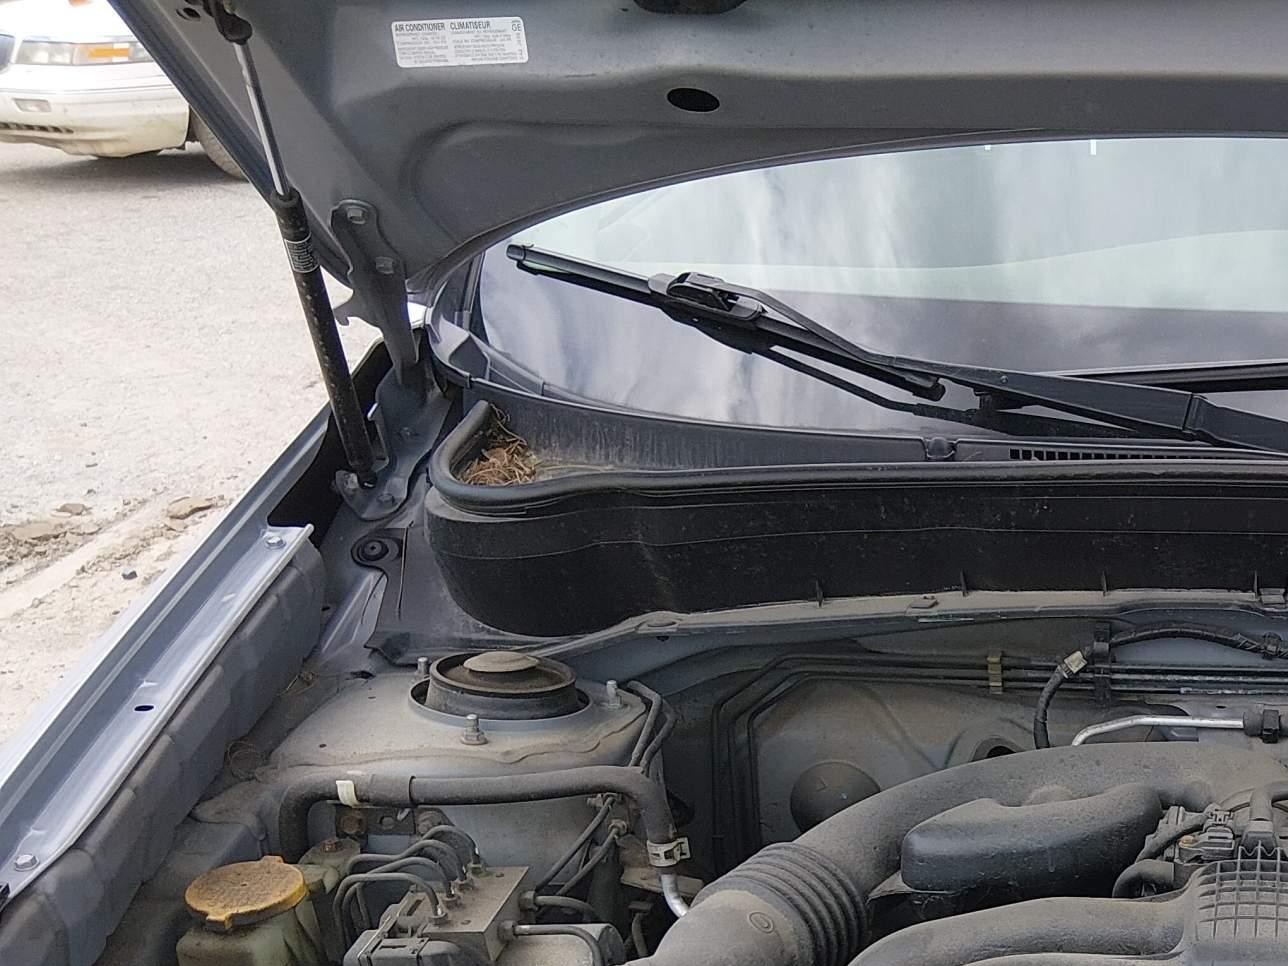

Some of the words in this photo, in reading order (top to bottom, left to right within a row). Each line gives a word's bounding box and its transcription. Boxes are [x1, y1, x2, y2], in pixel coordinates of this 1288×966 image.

[395, 24, 404, 32] AIR
[406, 22, 446, 32] CONDITIONER
[450, 20, 490, 30] CLIMATISEUR
